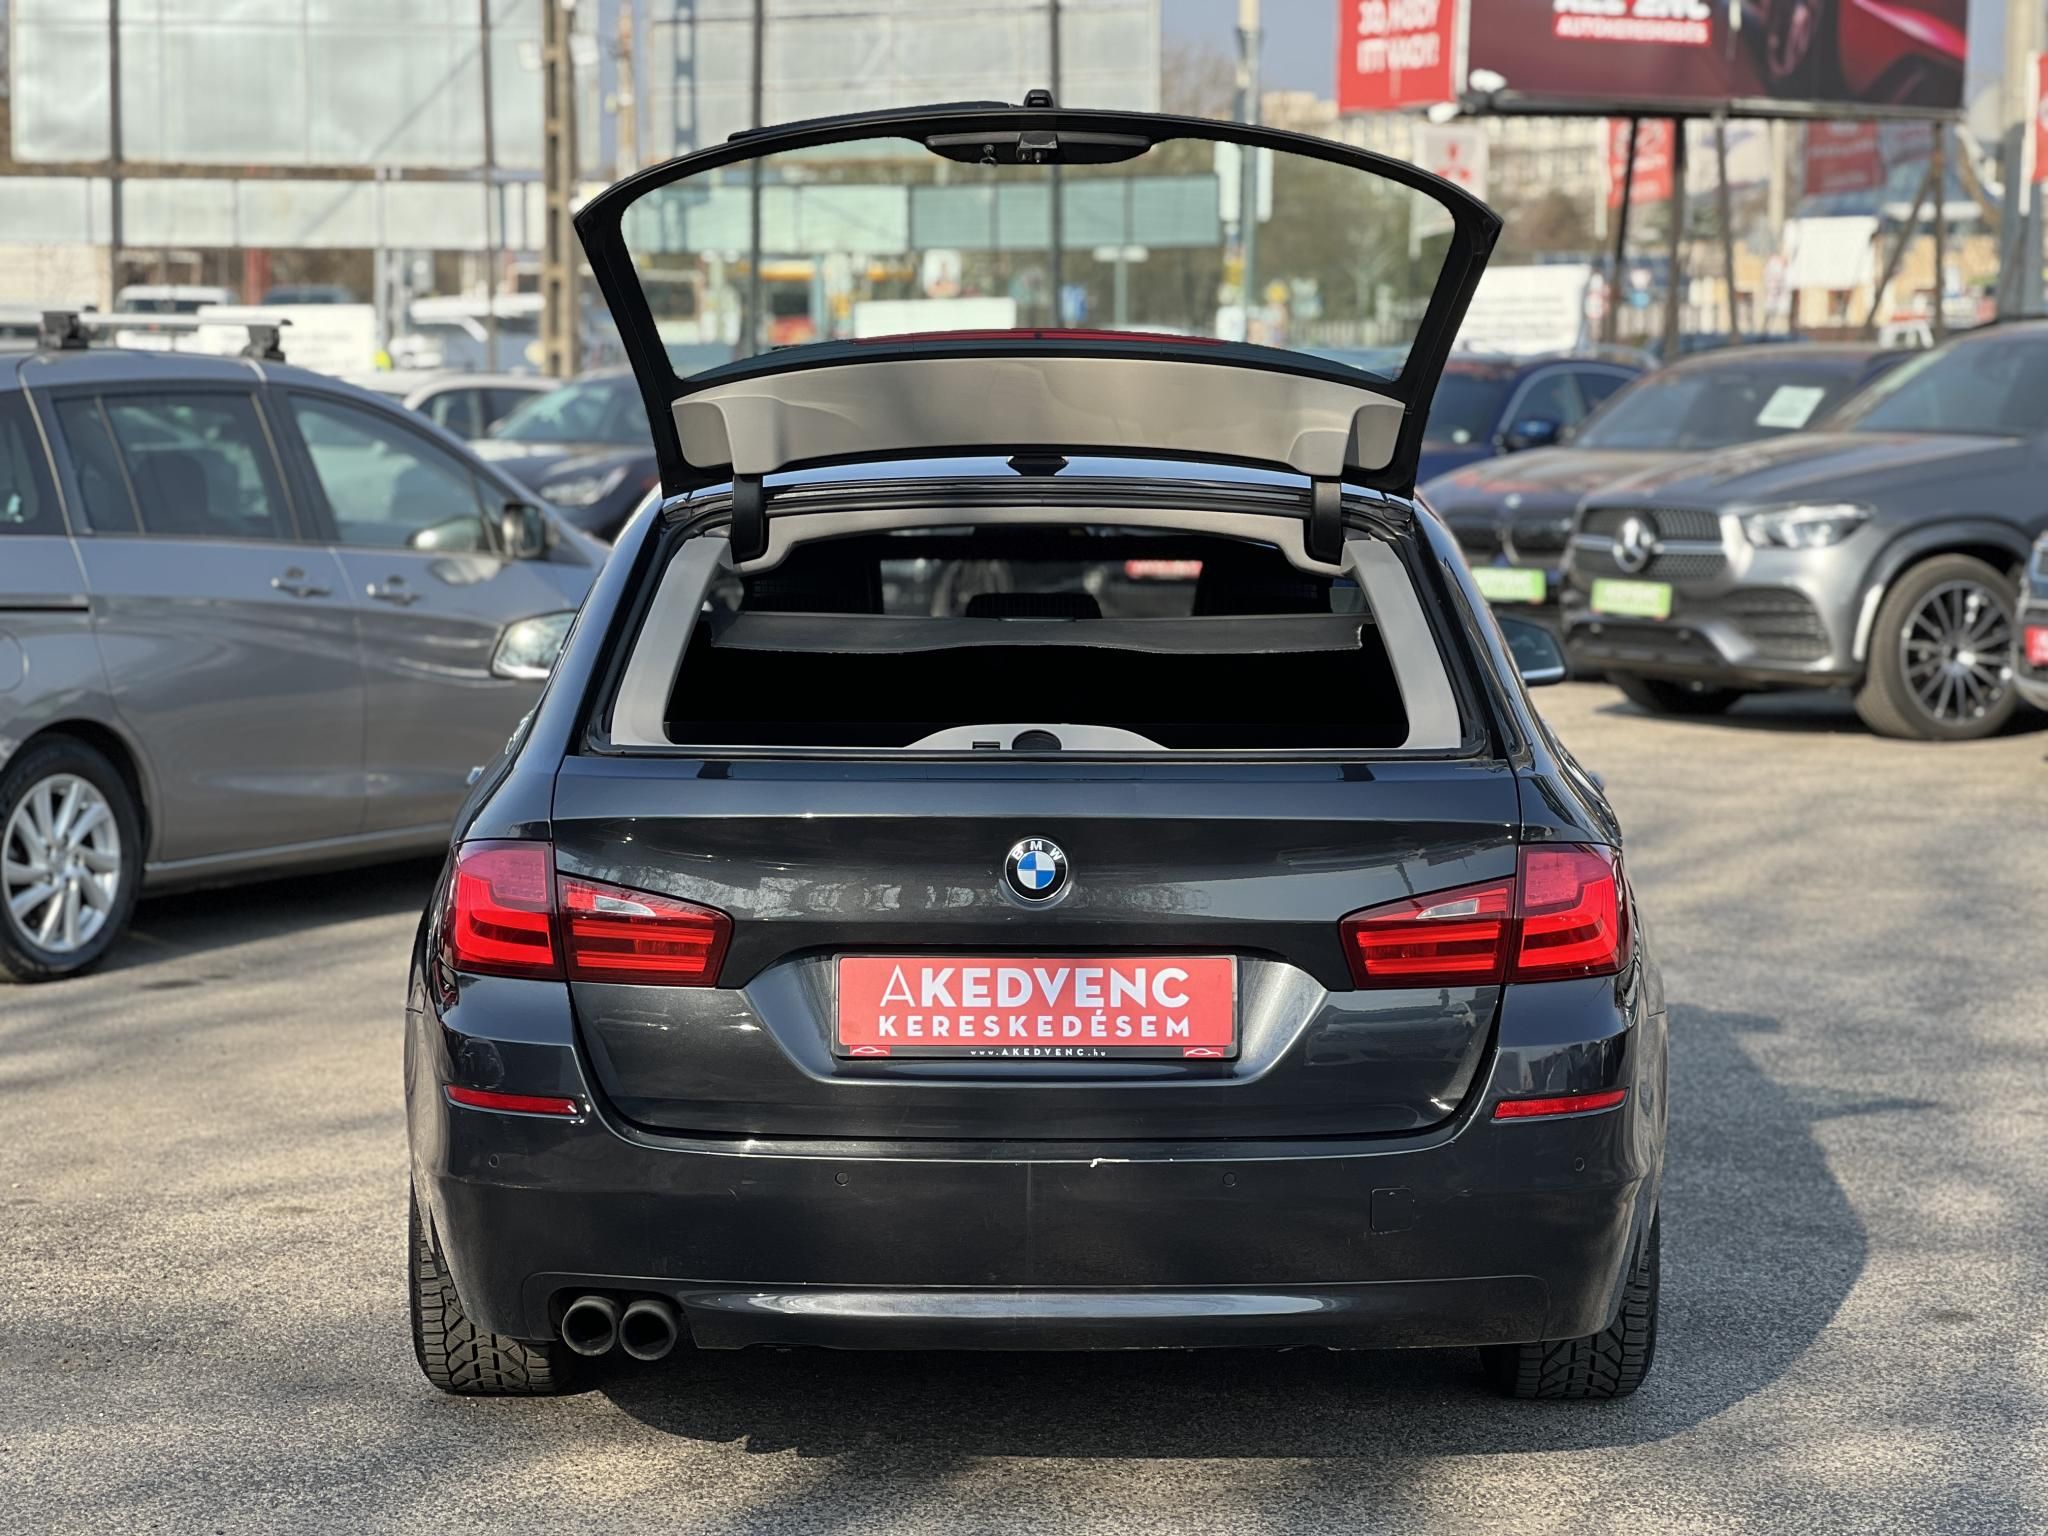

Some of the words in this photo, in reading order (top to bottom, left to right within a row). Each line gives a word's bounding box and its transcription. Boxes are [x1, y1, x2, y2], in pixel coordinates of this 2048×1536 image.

[1011, 840, 1063, 861] BMW
[878, 1009, 1191, 1037] KERESKEDÉSEM
[970, 1047, 1106, 1057] www.AKEDVENC.hu
